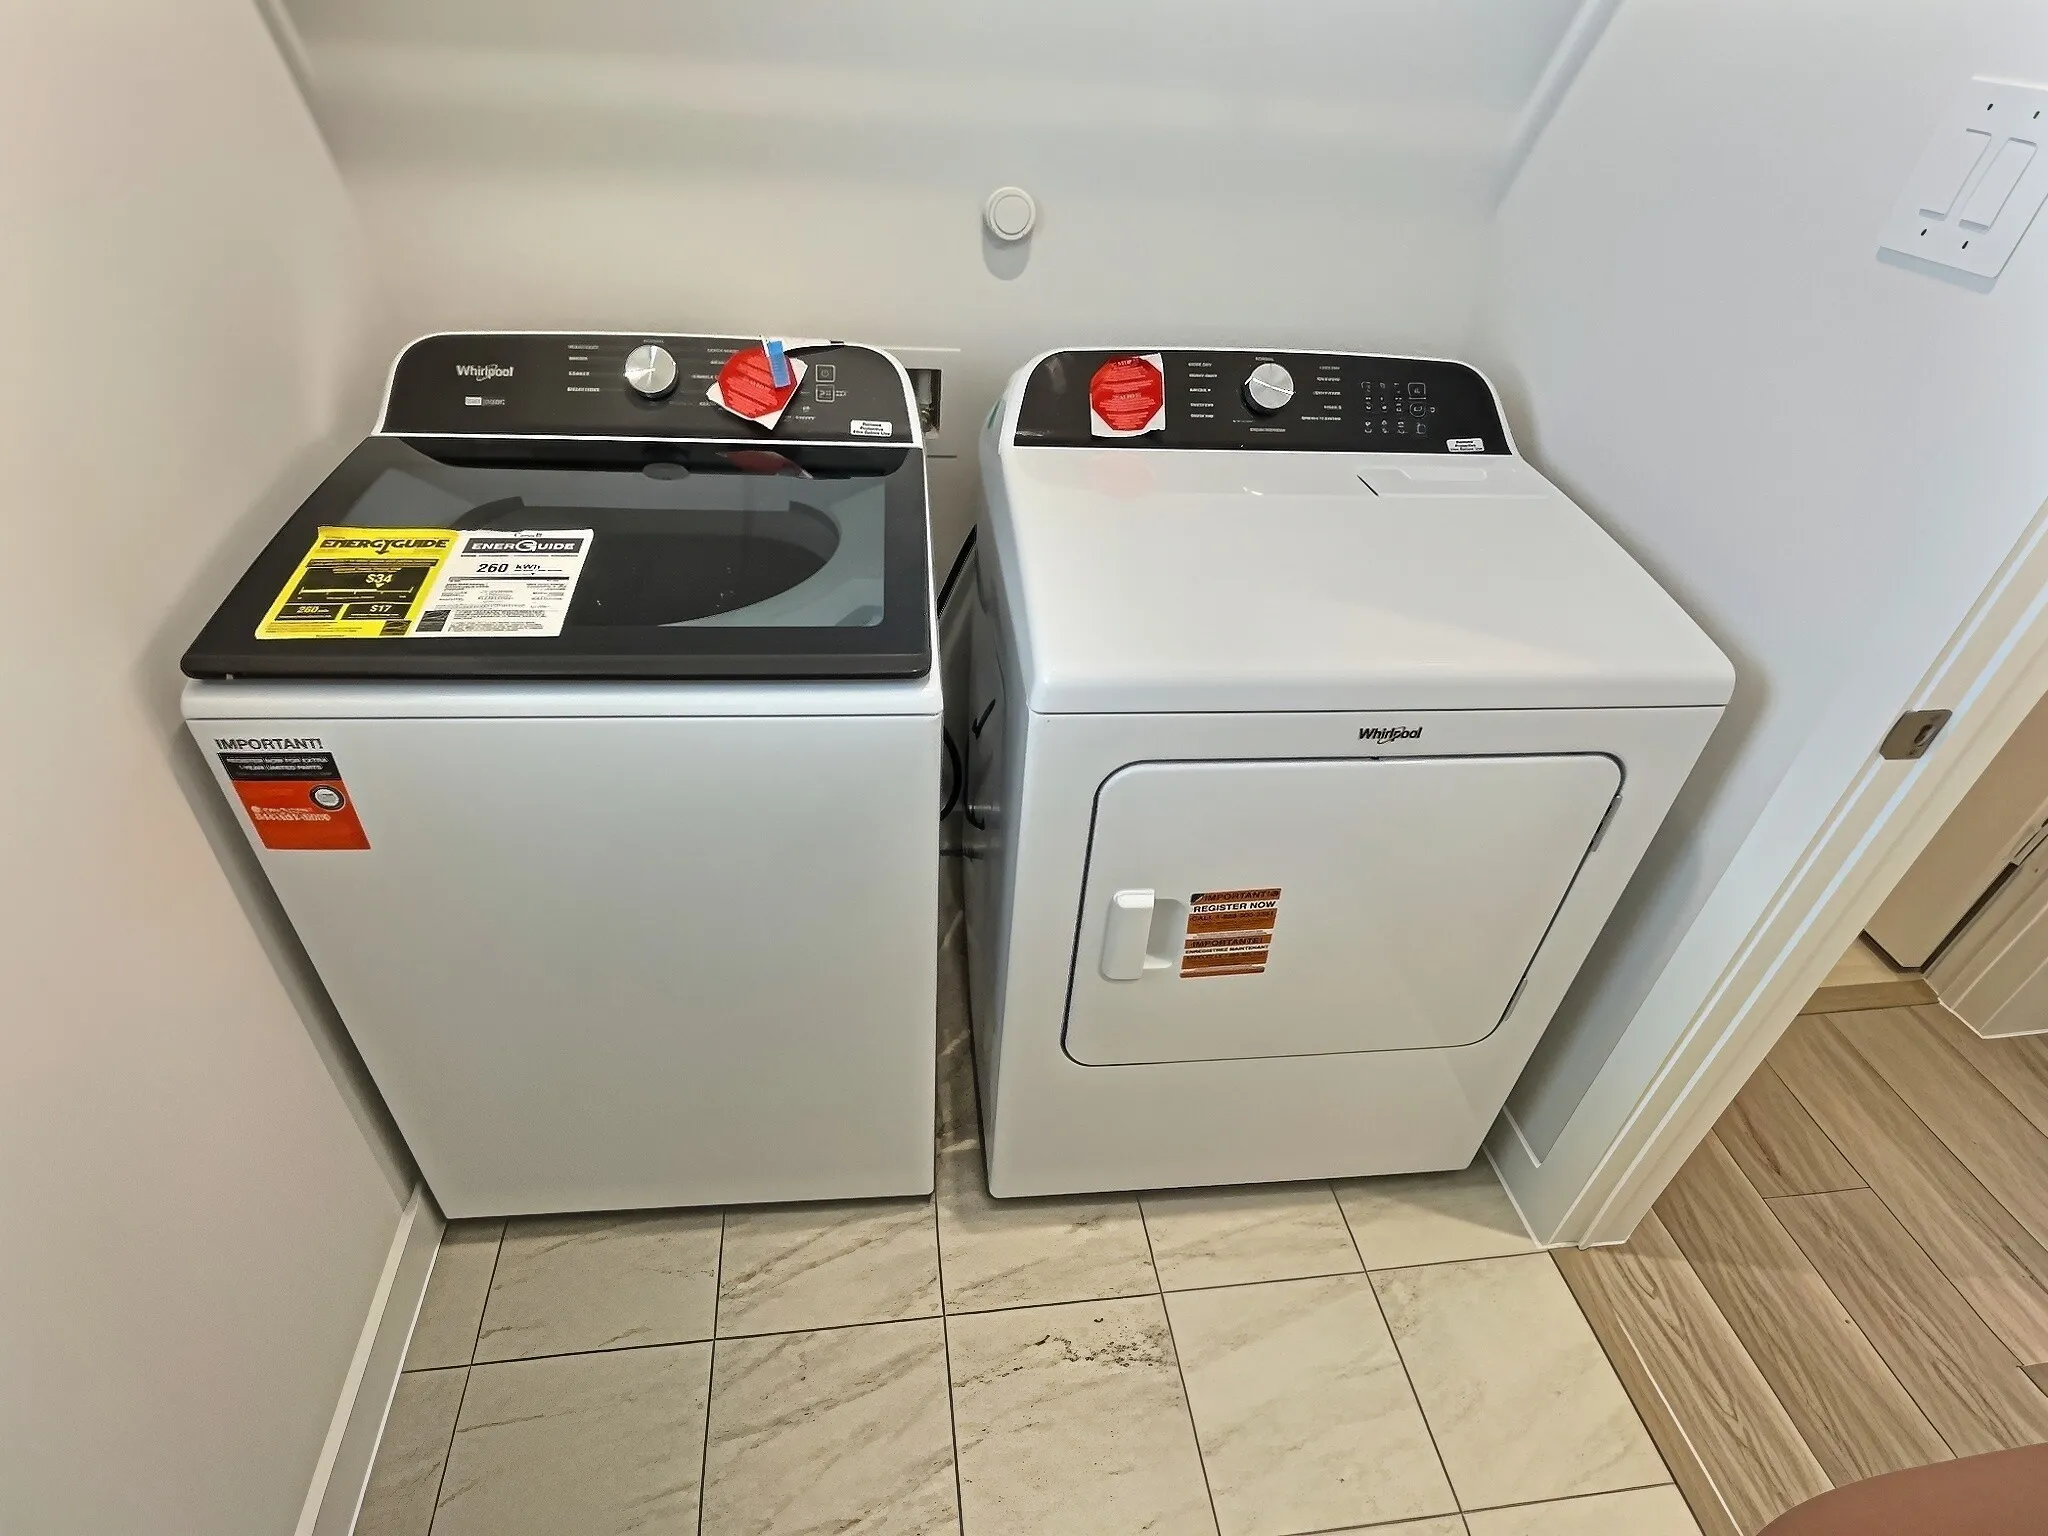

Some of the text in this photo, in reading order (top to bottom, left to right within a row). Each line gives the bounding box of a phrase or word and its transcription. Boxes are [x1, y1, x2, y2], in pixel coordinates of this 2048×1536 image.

[456, 364, 514, 382] Whirlpool
[320, 539, 450, 555] ENERGYGUIDE
[471, 539, 576, 552] ENERGUIDE
[476, 563, 509, 573] 260
[1359, 726, 1423, 745] Whirlpool
[214, 738, 324, 750] IMPORTANT!
[1194, 901, 1276, 913] REGISTER NOW
